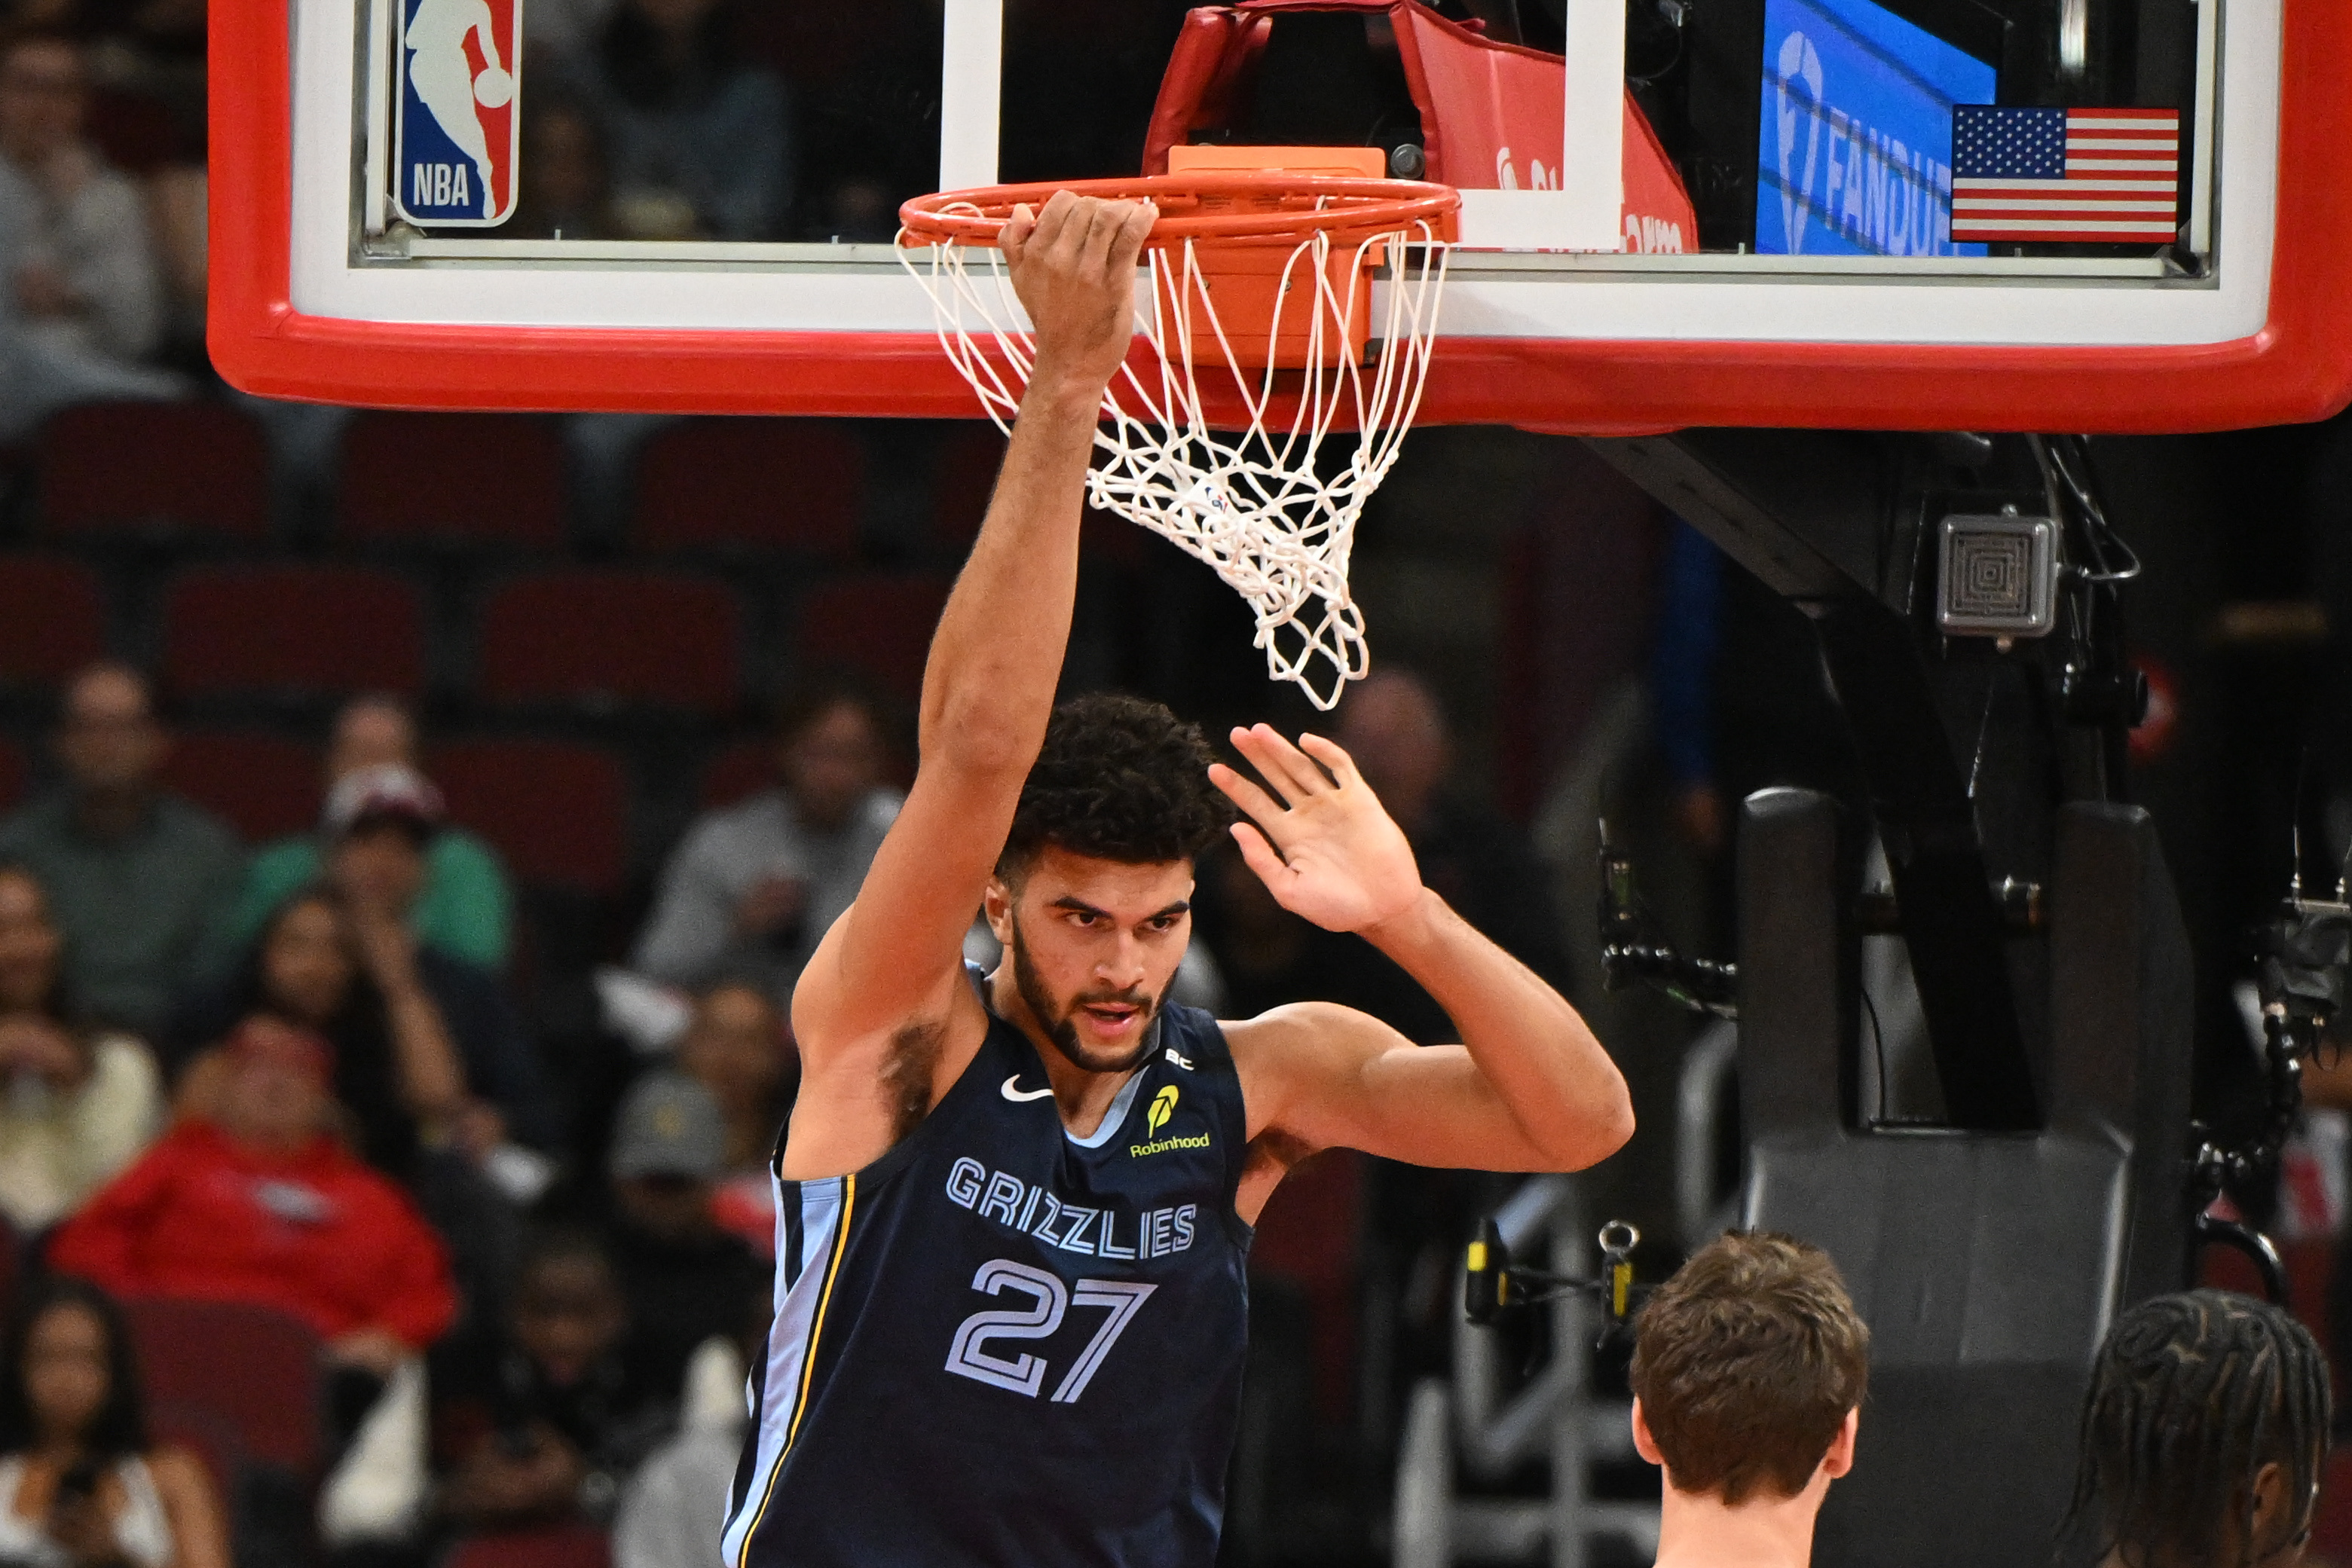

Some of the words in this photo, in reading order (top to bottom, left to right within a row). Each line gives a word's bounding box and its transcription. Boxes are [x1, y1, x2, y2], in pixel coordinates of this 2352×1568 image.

[414, 163, 469, 206] NBA
[1130, 1132, 1210, 1158] Robinhood
[946, 1157, 1196, 1260] GRIZZLIES
[945, 1258, 1158, 1403] 27
